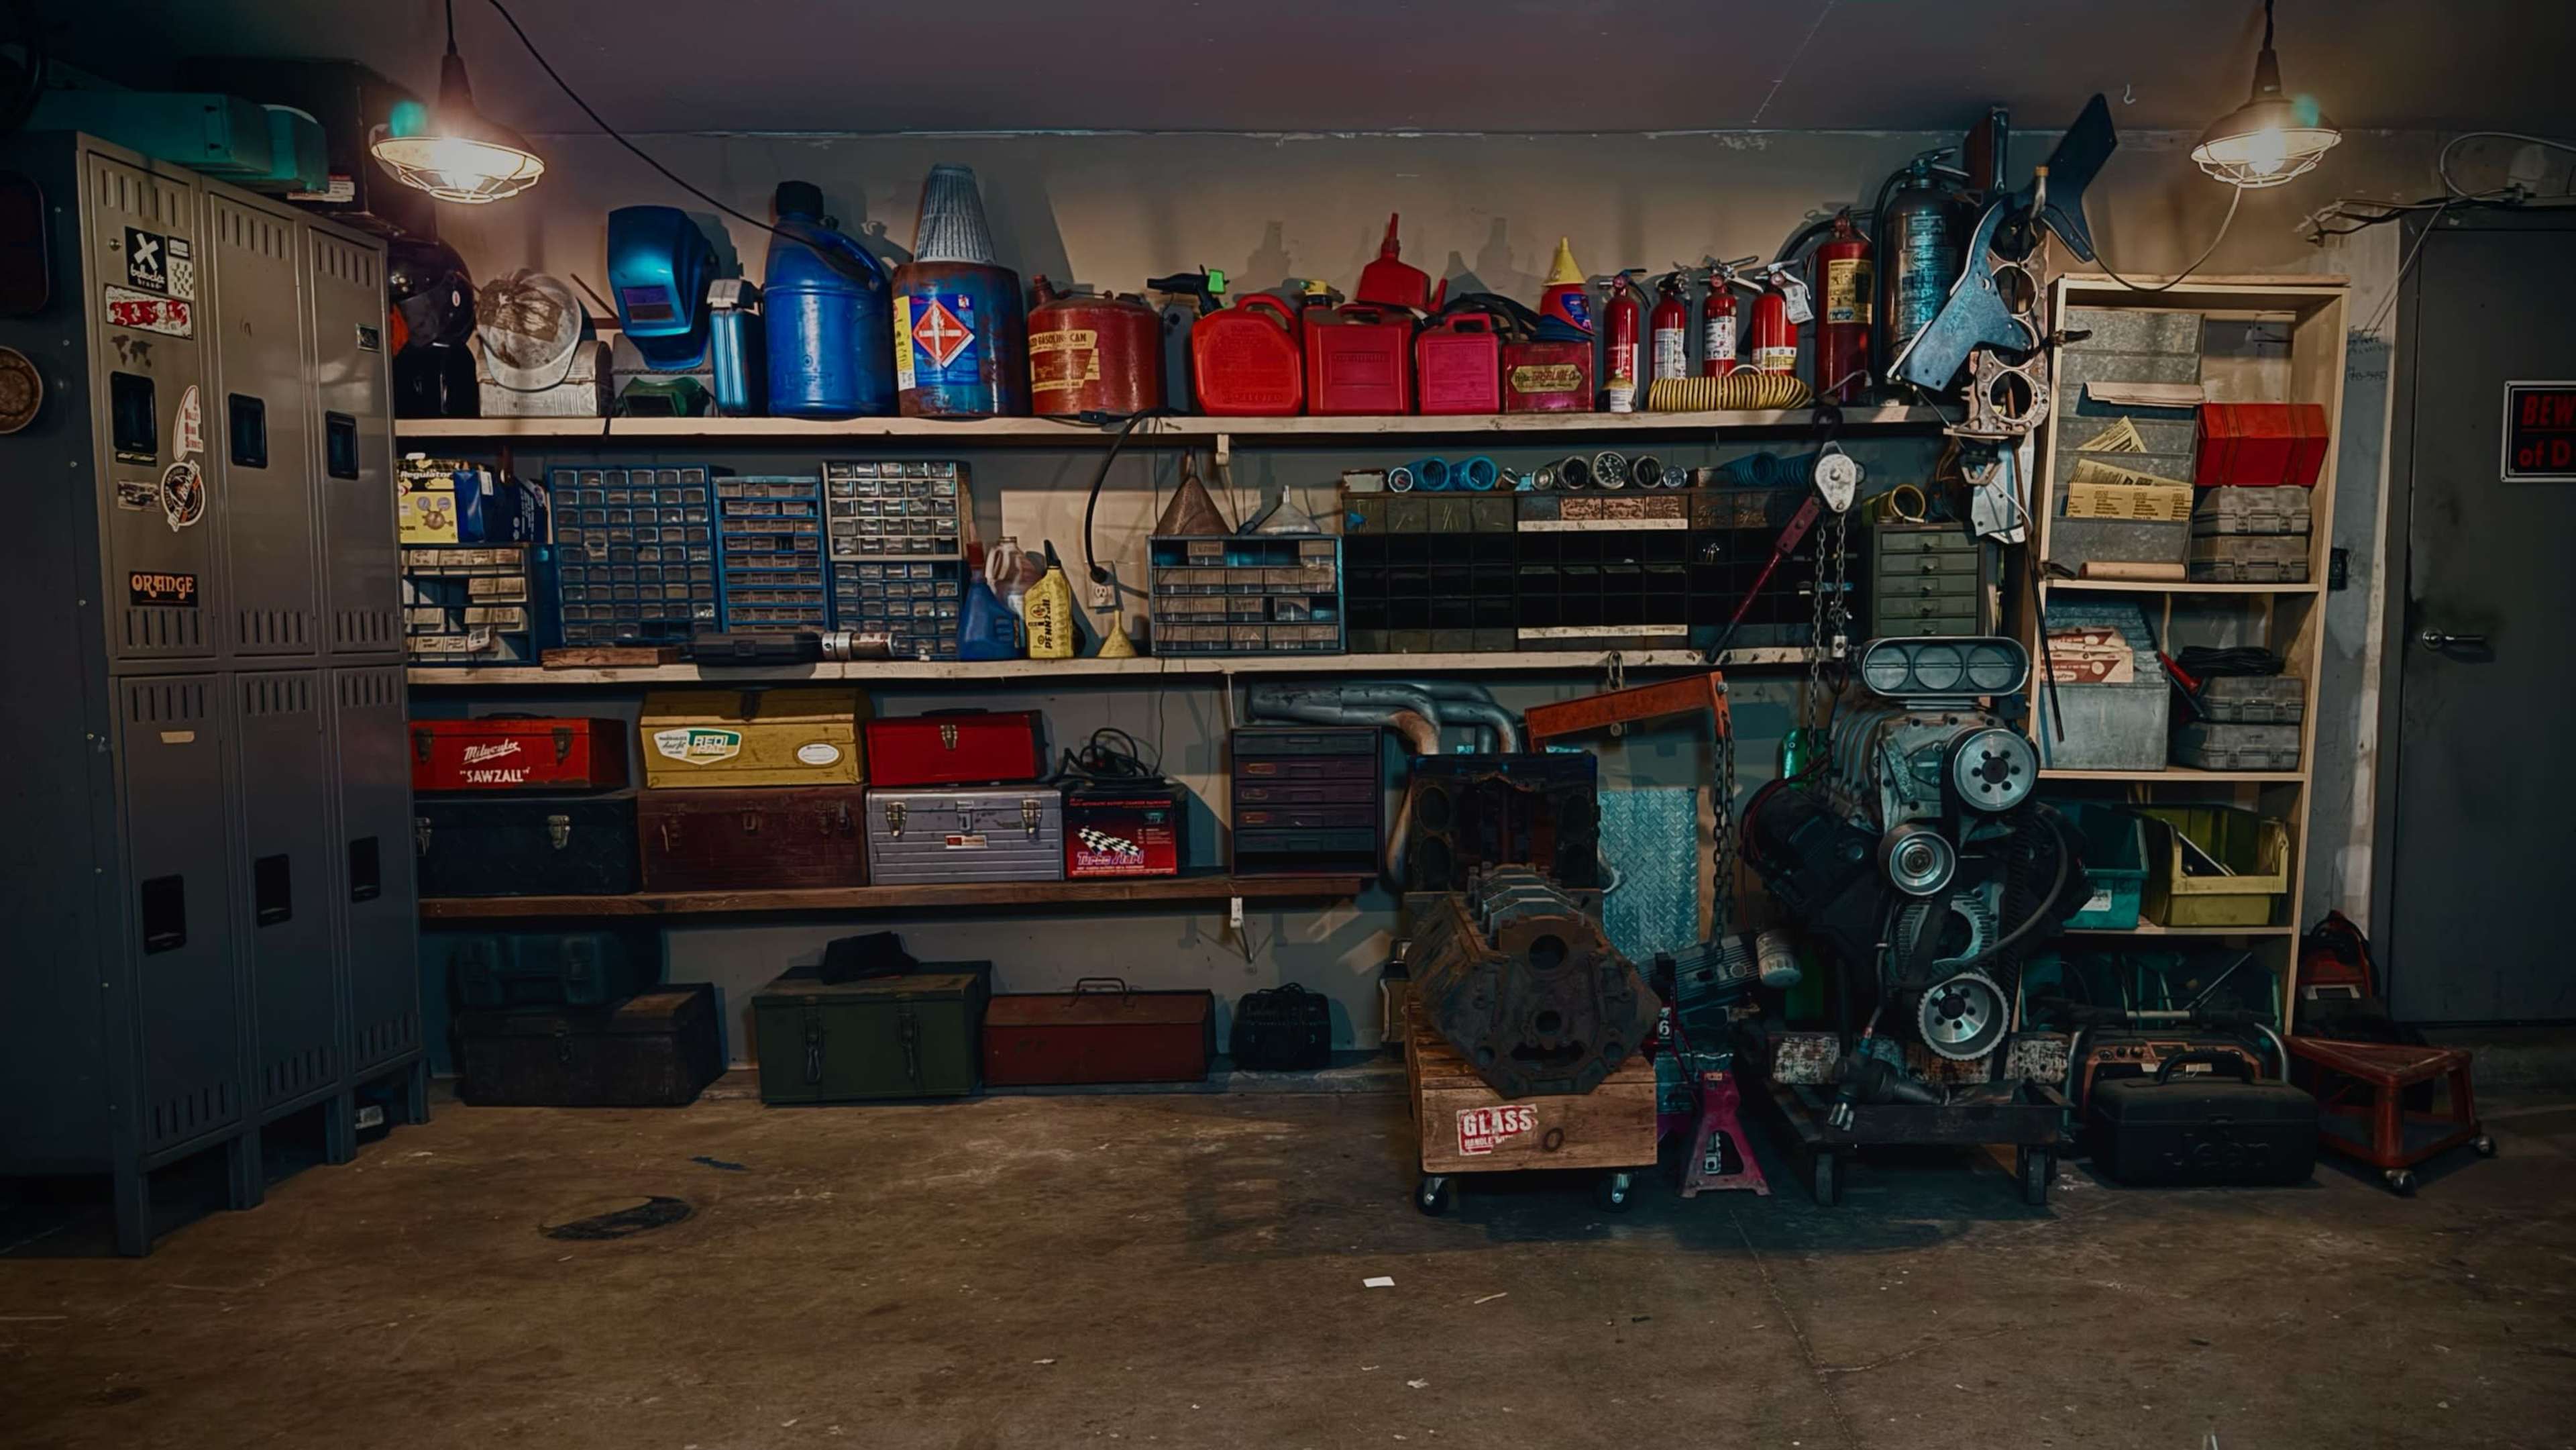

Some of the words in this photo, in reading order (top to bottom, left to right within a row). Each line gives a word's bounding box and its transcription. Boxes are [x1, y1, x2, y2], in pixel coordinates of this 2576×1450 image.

[1070, 333, 1087, 342] CAN
[2518, 439, 2545, 468] of
[2551, 439, 2576, 468] D
[400, 470, 454, 480] Regulator
[131, 574, 195, 600] ORANGE
[463, 738, 519, 761] Milwaukee
[1658, 1020, 1670, 1035] 6
[1463, 1109, 1532, 1137] GLASS
